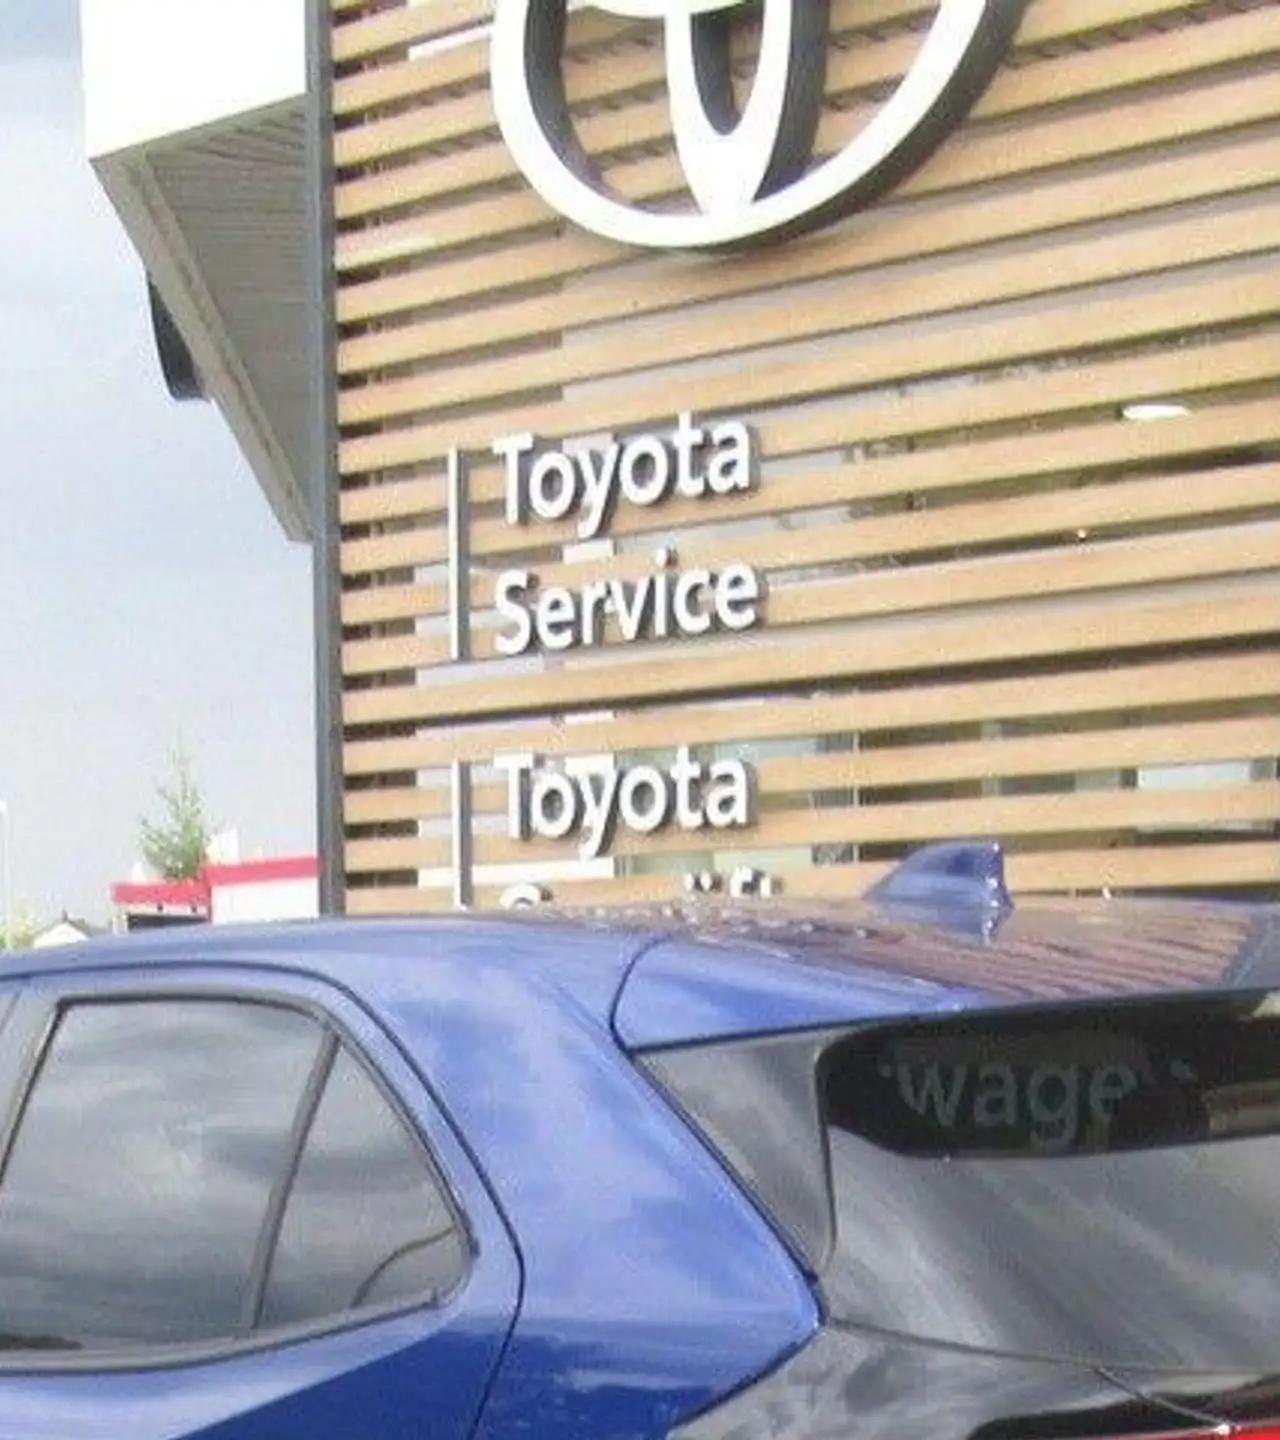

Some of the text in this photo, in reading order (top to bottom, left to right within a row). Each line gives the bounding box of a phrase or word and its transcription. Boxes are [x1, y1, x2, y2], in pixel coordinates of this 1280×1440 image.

[493, 411, 750, 538] Toyota
[495, 547, 759, 655] Service
[493, 745, 749, 860] Toyota
